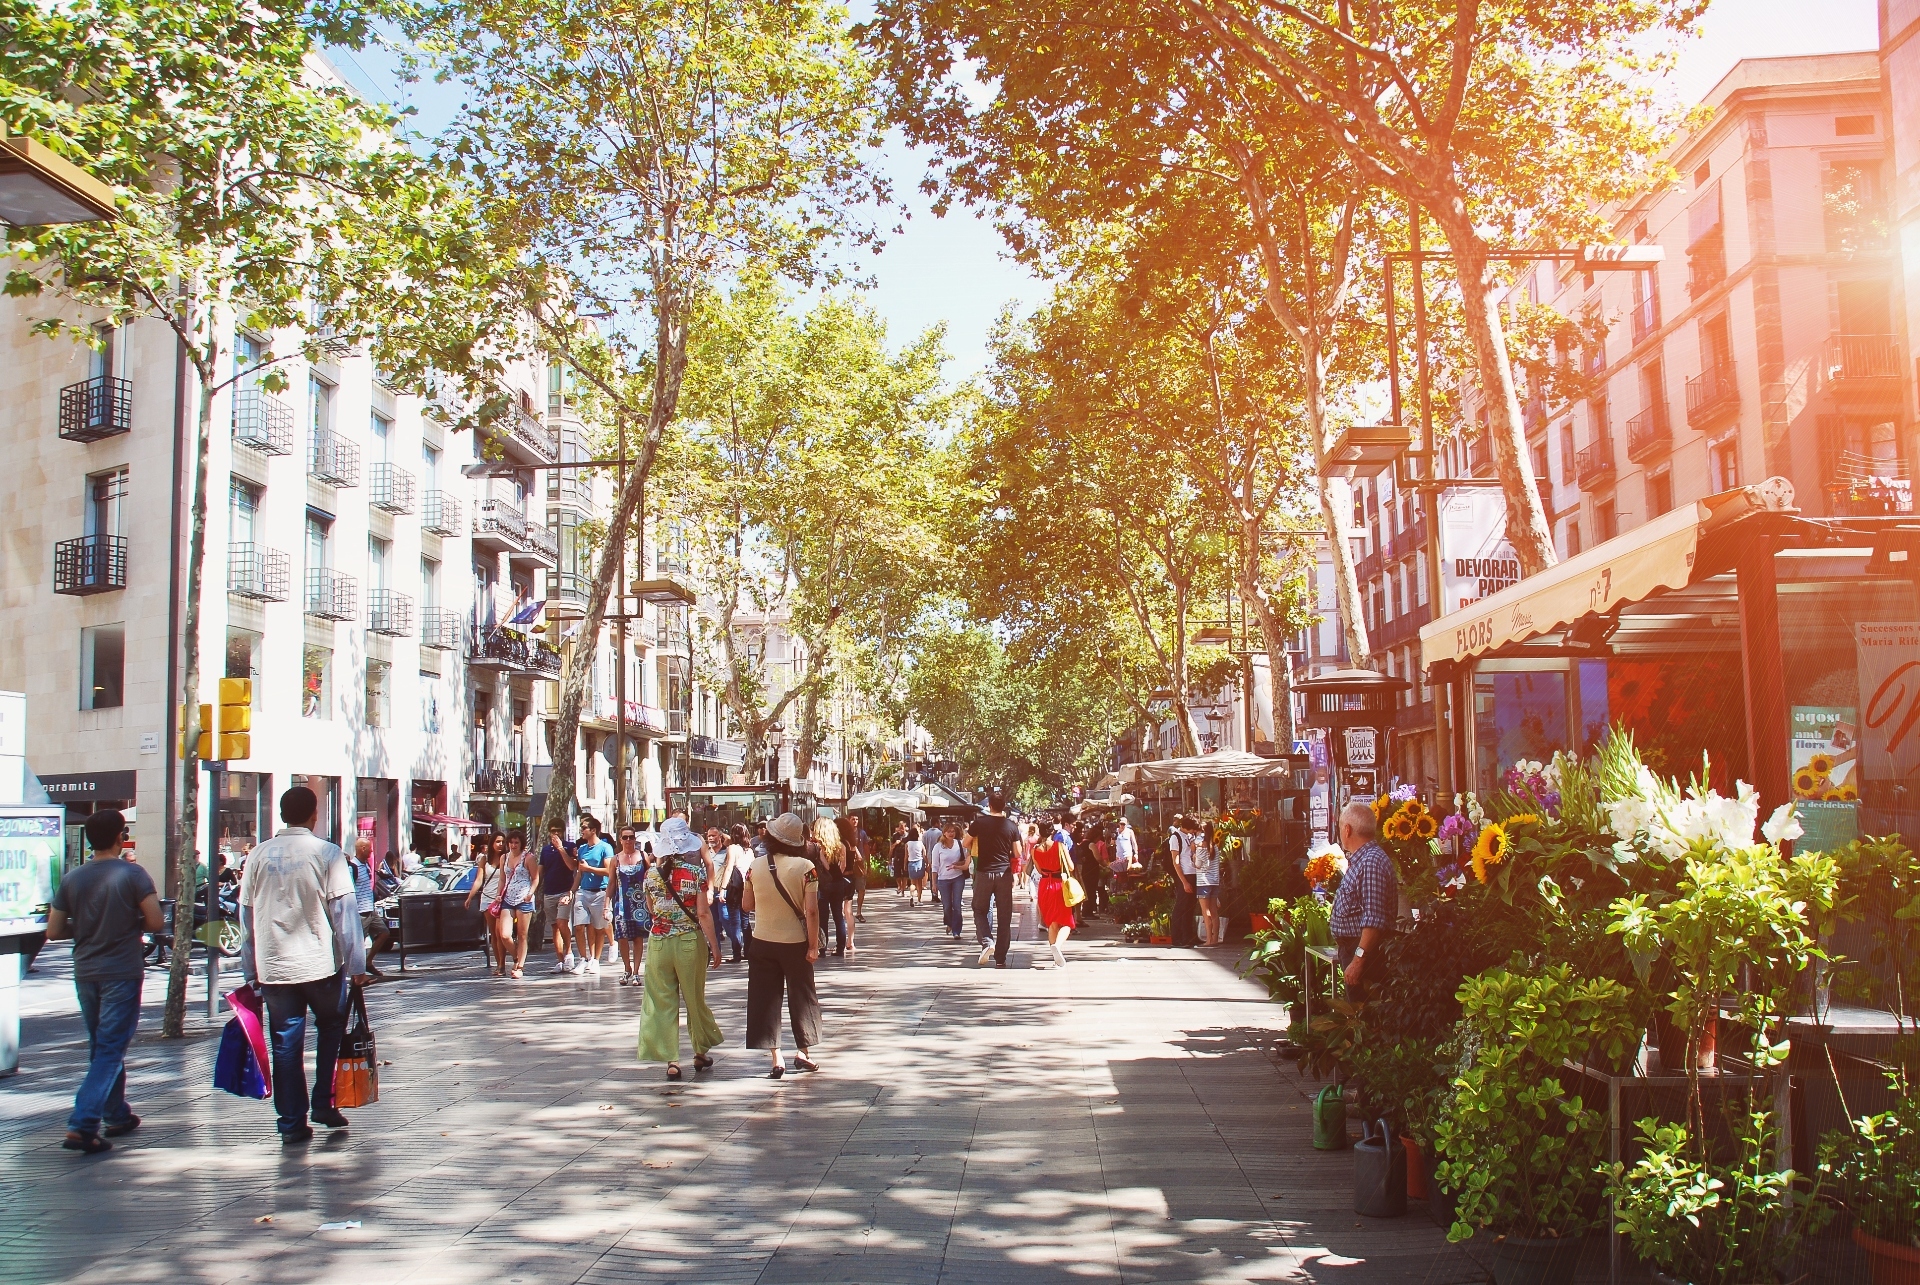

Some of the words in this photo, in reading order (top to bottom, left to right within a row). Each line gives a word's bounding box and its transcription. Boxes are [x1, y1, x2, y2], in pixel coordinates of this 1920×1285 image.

[1455, 558, 1518, 578] DEVORAR
[1479, 579, 1518, 597] PAR
[1456, 617, 1493, 654] FLORS
[1601, 567, 1612, 602] 7
[1860, 624, 1914, 633] Successors
[1861, 637, 1893, 646] Maria
[1795, 730, 1822, 739] amb
[1350, 736, 1373, 749] Beatles
[1795, 740, 1825, 749] flors
